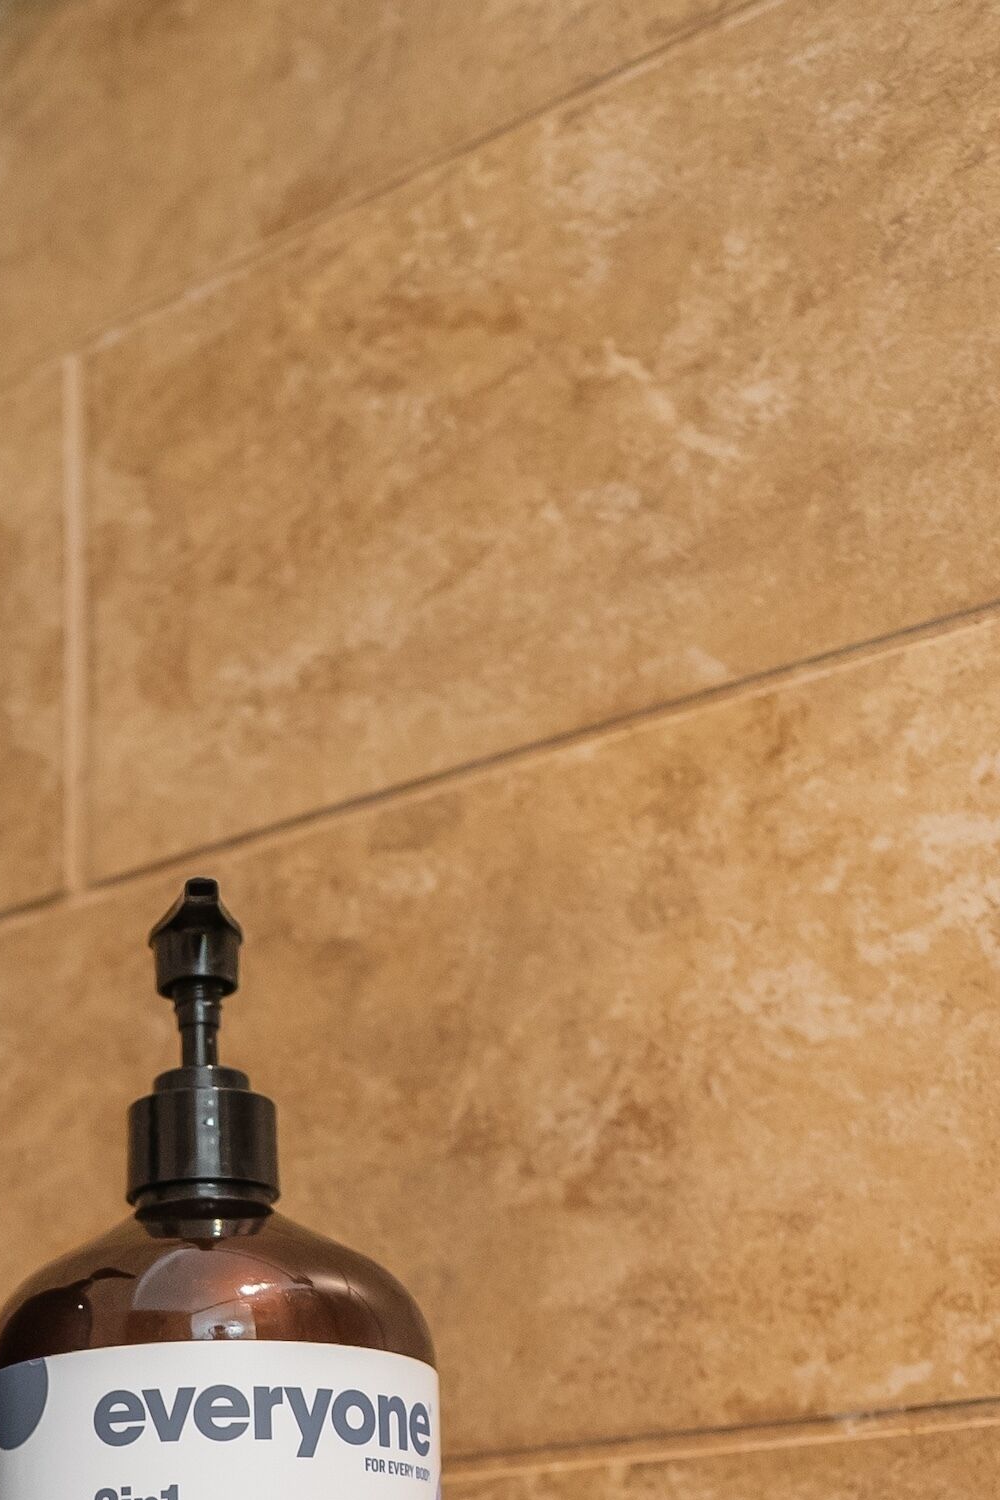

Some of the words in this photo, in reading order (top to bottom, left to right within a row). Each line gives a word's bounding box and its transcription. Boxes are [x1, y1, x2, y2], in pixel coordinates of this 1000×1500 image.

[94, 1384, 431, 1457] everyone
[365, 1457, 385, 1473] FOR
[388, 1462, 414, 1477] EVERY
